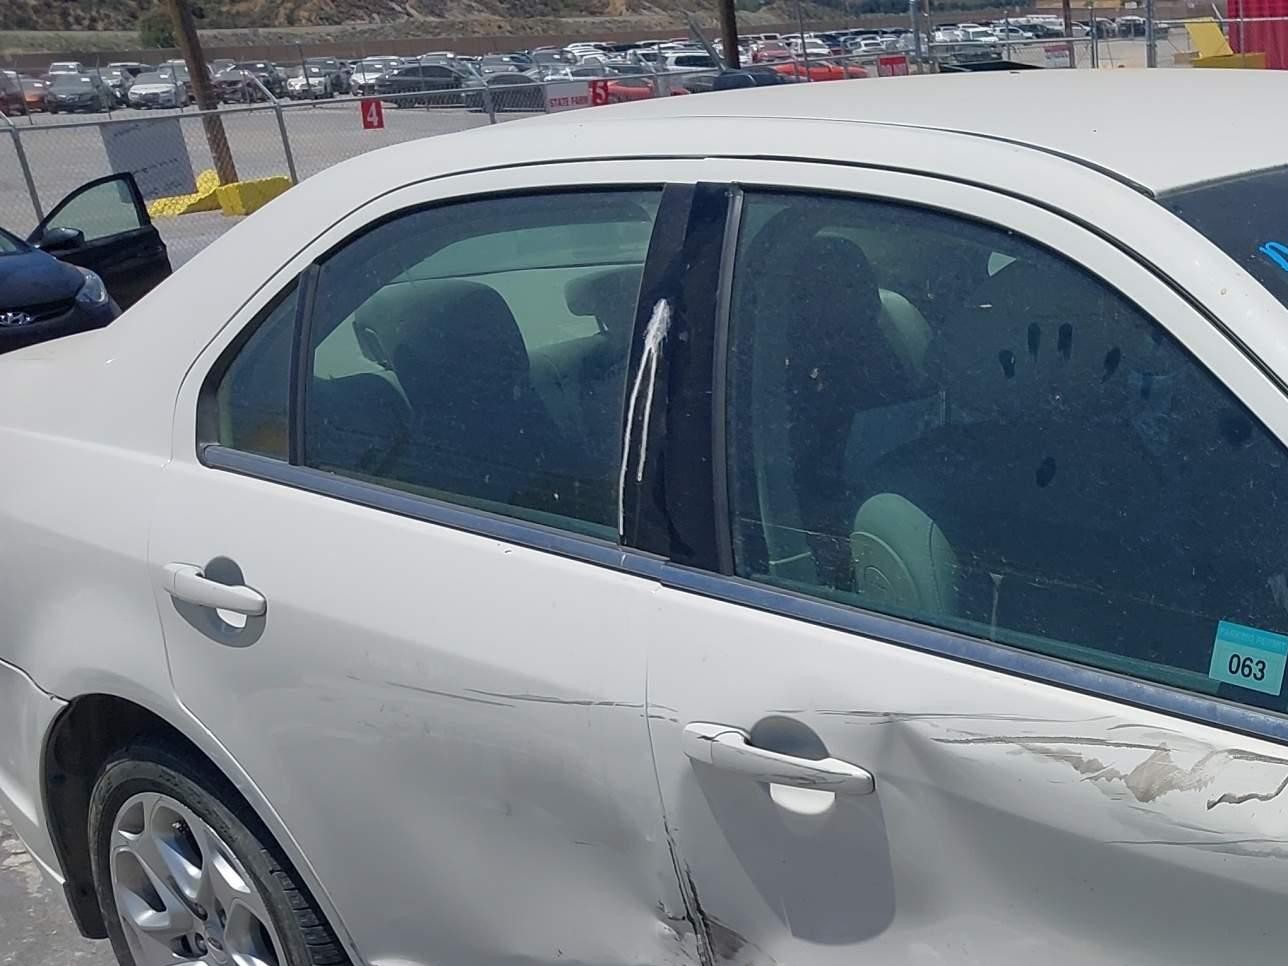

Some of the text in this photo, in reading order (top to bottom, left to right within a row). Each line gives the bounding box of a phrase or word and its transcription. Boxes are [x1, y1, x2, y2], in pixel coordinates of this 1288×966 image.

[595, 80, 607, 104] 5
[366, 101, 379, 127] 4
[1228, 653, 1267, 682] 063
